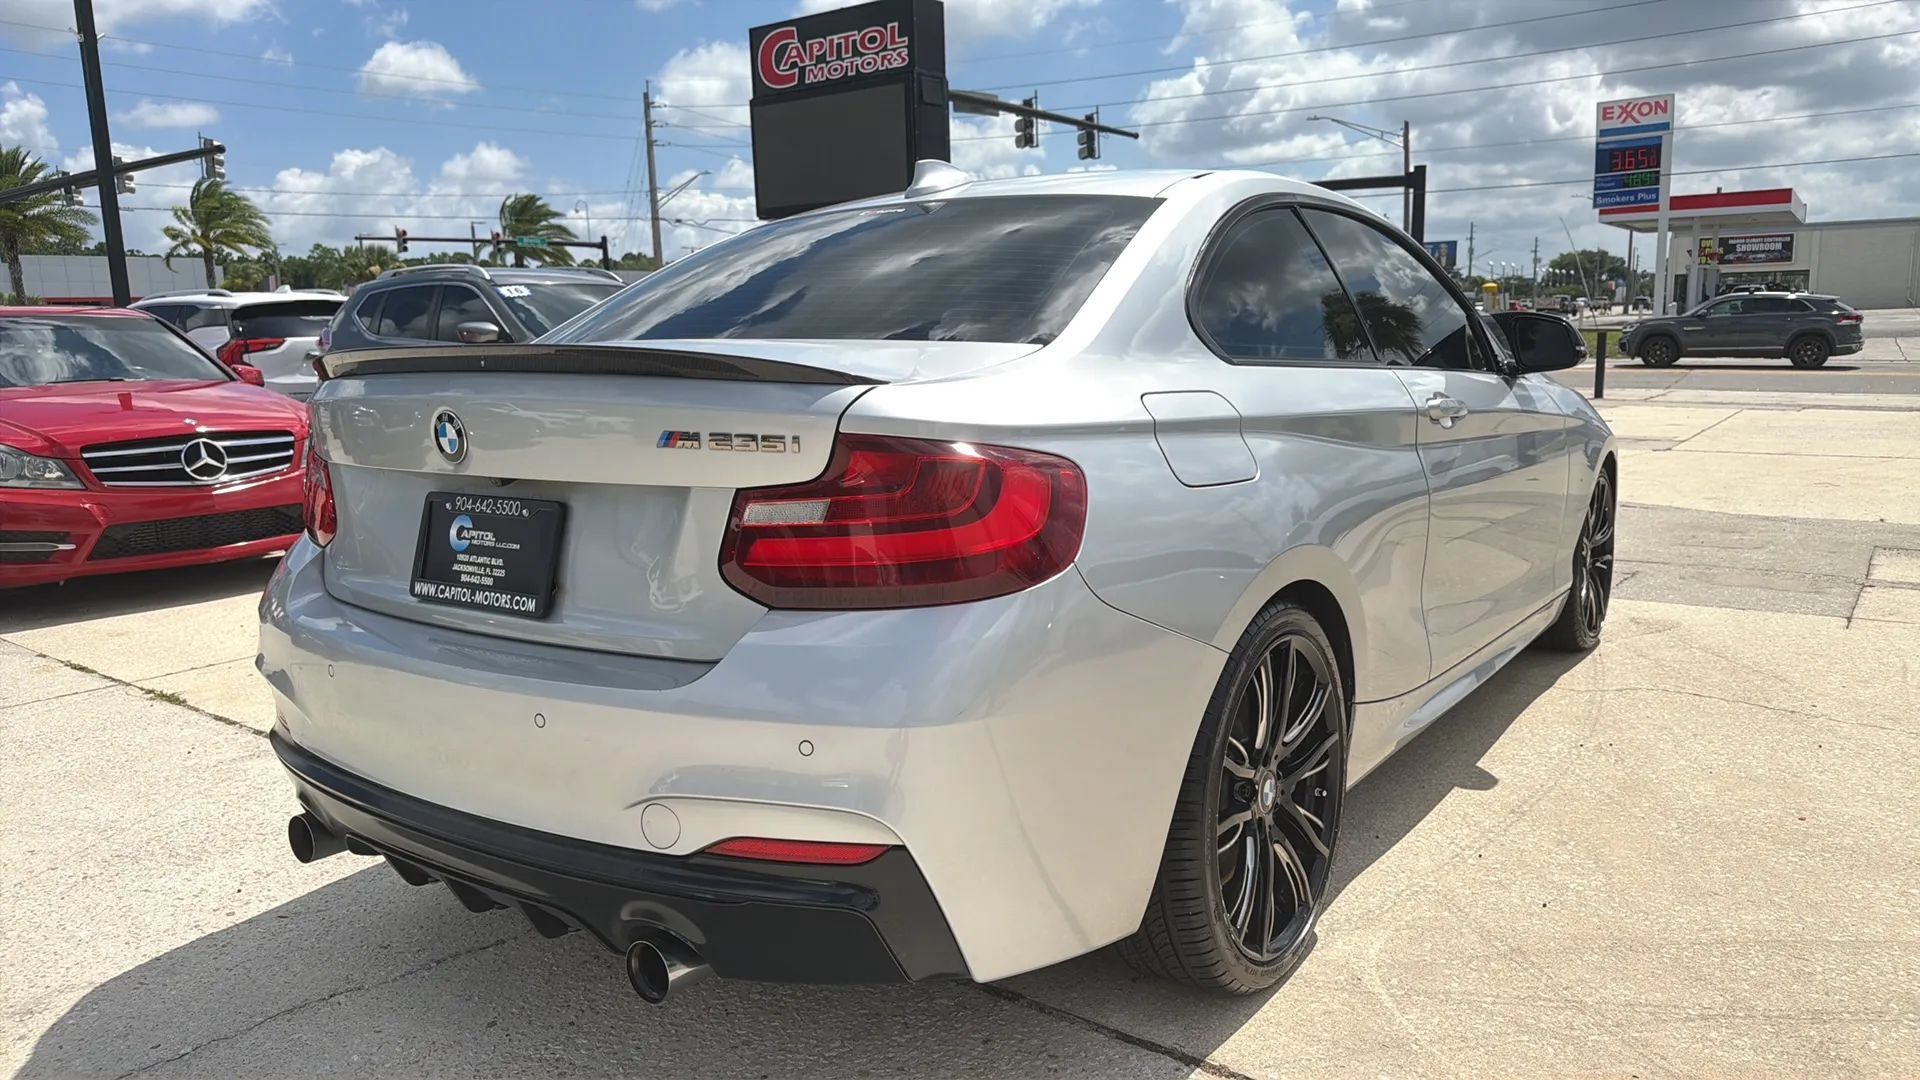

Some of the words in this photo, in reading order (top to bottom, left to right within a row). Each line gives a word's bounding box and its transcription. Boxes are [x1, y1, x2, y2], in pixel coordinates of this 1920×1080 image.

[758, 22, 909, 89] CAPITOL
[805, 48, 909, 84] MOTORS
[1602, 99, 1669, 124] EXXON
[1596, 194, 1635, 205] Smokers
[1637, 192, 1657, 201] Plus
[1736, 242, 1783, 252] SHOWROOM
[455, 496, 521, 516] 904-642-5500
[449, 514, 496, 552] CAPITOL
[471, 539, 495, 548] MOTORS
[469, 554, 491, 566] ATLANTIC
[460, 574, 494, 586] 904-642-5500
[414, 581, 536, 612] WWW.CAPITOL-MOTORS.COM
